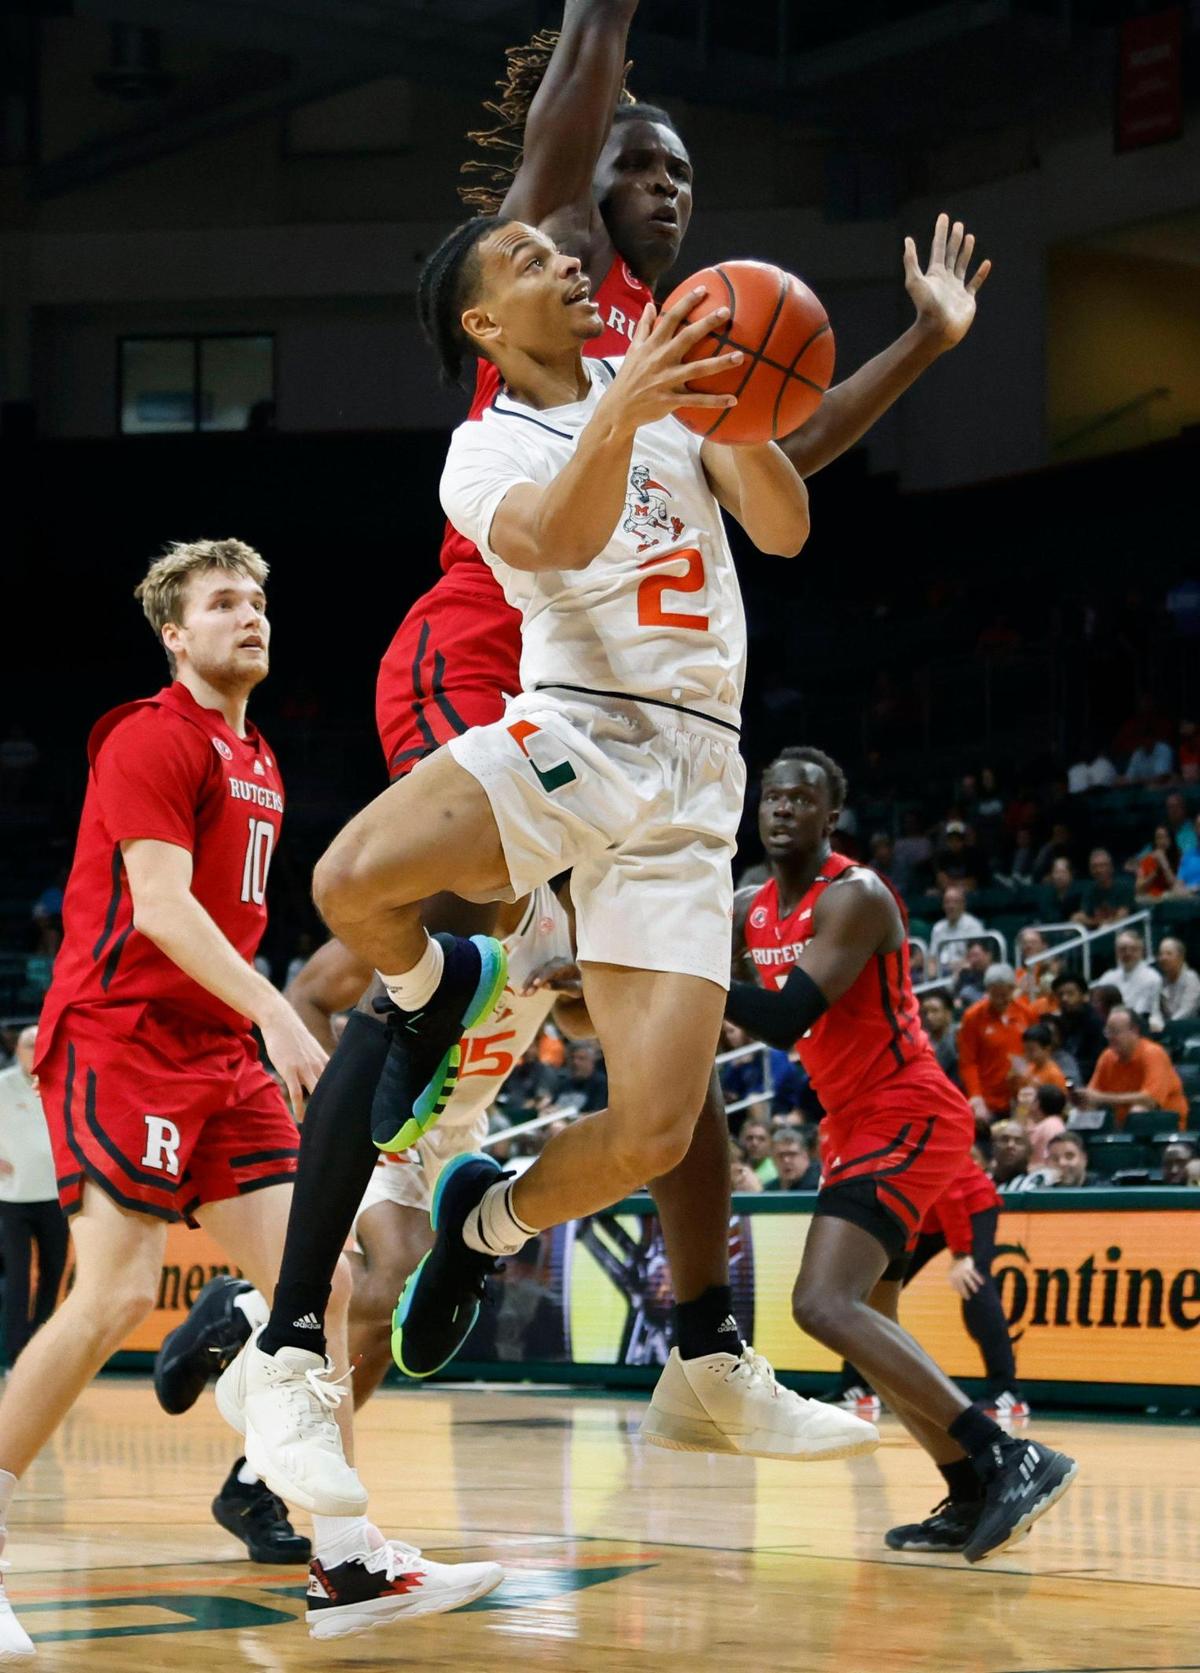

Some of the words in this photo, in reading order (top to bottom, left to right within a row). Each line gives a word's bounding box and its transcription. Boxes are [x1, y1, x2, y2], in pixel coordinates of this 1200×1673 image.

[634, 504, 649, 517] M
[637, 548, 709, 632] 2
[241, 818, 275, 905] 10
[141, 1115, 181, 1176] R
